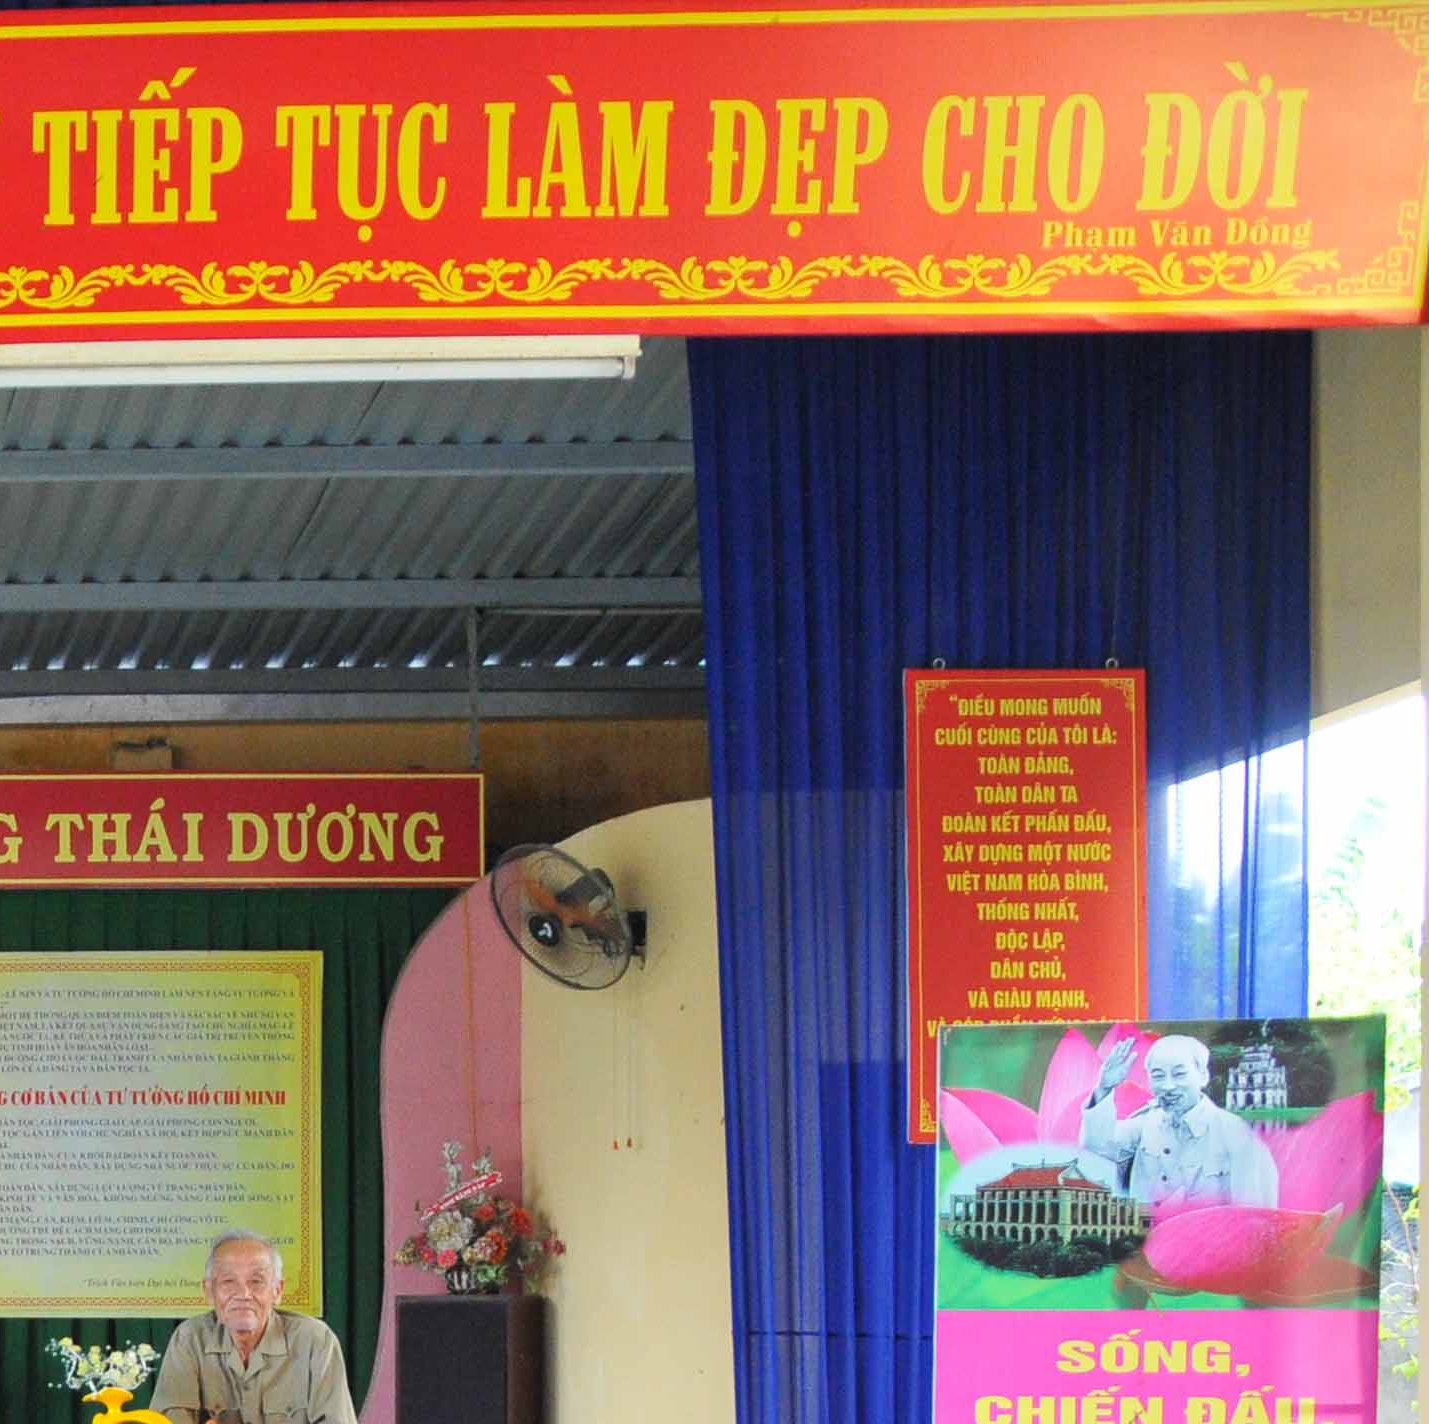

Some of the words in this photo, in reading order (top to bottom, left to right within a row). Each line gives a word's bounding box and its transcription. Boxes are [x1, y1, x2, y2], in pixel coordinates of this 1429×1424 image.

[33, 68, 243, 225] TIẾP
[276, 103, 448, 241] TỤC
[482, 75, 673, 218] LÀM
[705, 98, 889, 237] ĐẸP
[923, 94, 1105, 214] CHO
[1136, 63, 1309, 210] ĐỜI
[1042, 219, 1137, 251] Phạm
[1150, 217, 1212, 248] Văn
[1225, 215, 1312, 249] Đồng
[1000, 698, 1048, 716] MONG
[1053, 692, 1101, 716] MUỐN
[935, 723, 972, 745] CUỐI
[977, 723, 1021, 745] CÙNG
[1026, 722, 1058, 745] CỦA
[1063, 723, 1088, 745] TÔI
[1092, 723, 1117, 744] LÀ:
[978, 754, 1020, 775] TOÀN
[1024, 751, 1074, 775] ĐẢNG,
[975, 783, 1017, 804] TOÀN
[1022, 783, 1055, 803] DÂN
[1060, 785, 1077, 803] TA
[45, 798, 203, 863] THÁI
[227, 803, 444, 862] DƯƠNG
[942, 812, 986, 833] ĐOÀN
[991, 810, 1020, 833] KẾT
[1025, 809, 1069, 833] PHẤN
[1074, 808, 1112, 834] ĐẤU,
[943, 841, 975, 862] XÂY
[979, 842, 1023, 864] DỰNG
[1028, 840, 1063, 865] MỘT
[1067, 840, 1111, 862] NƯỚC
[947, 870, 981, 895] VIỆT
[985, 873, 1022, 891] NAM
[1028, 870, 1060, 891] HÒA
[1065, 870, 1108, 892] BÌNH,
[977, 897, 1029, 920] THỐNG
[1034, 896, 1078, 921] NHẤT,
[996, 929, 1027, 952] ĐỘC
[1033, 928, 1065, 952] LẬP,
[991, 958, 1023, 979] DÂN
[1029, 956, 1066, 981] CHỦ,
[968, 987, 988, 1008] VÀ
[994, 987, 1031, 1008] GIÀU
[1036, 990, 1089, 1011] MẠNH,
[1057, 1329, 1250, 1376] SỐNG,
